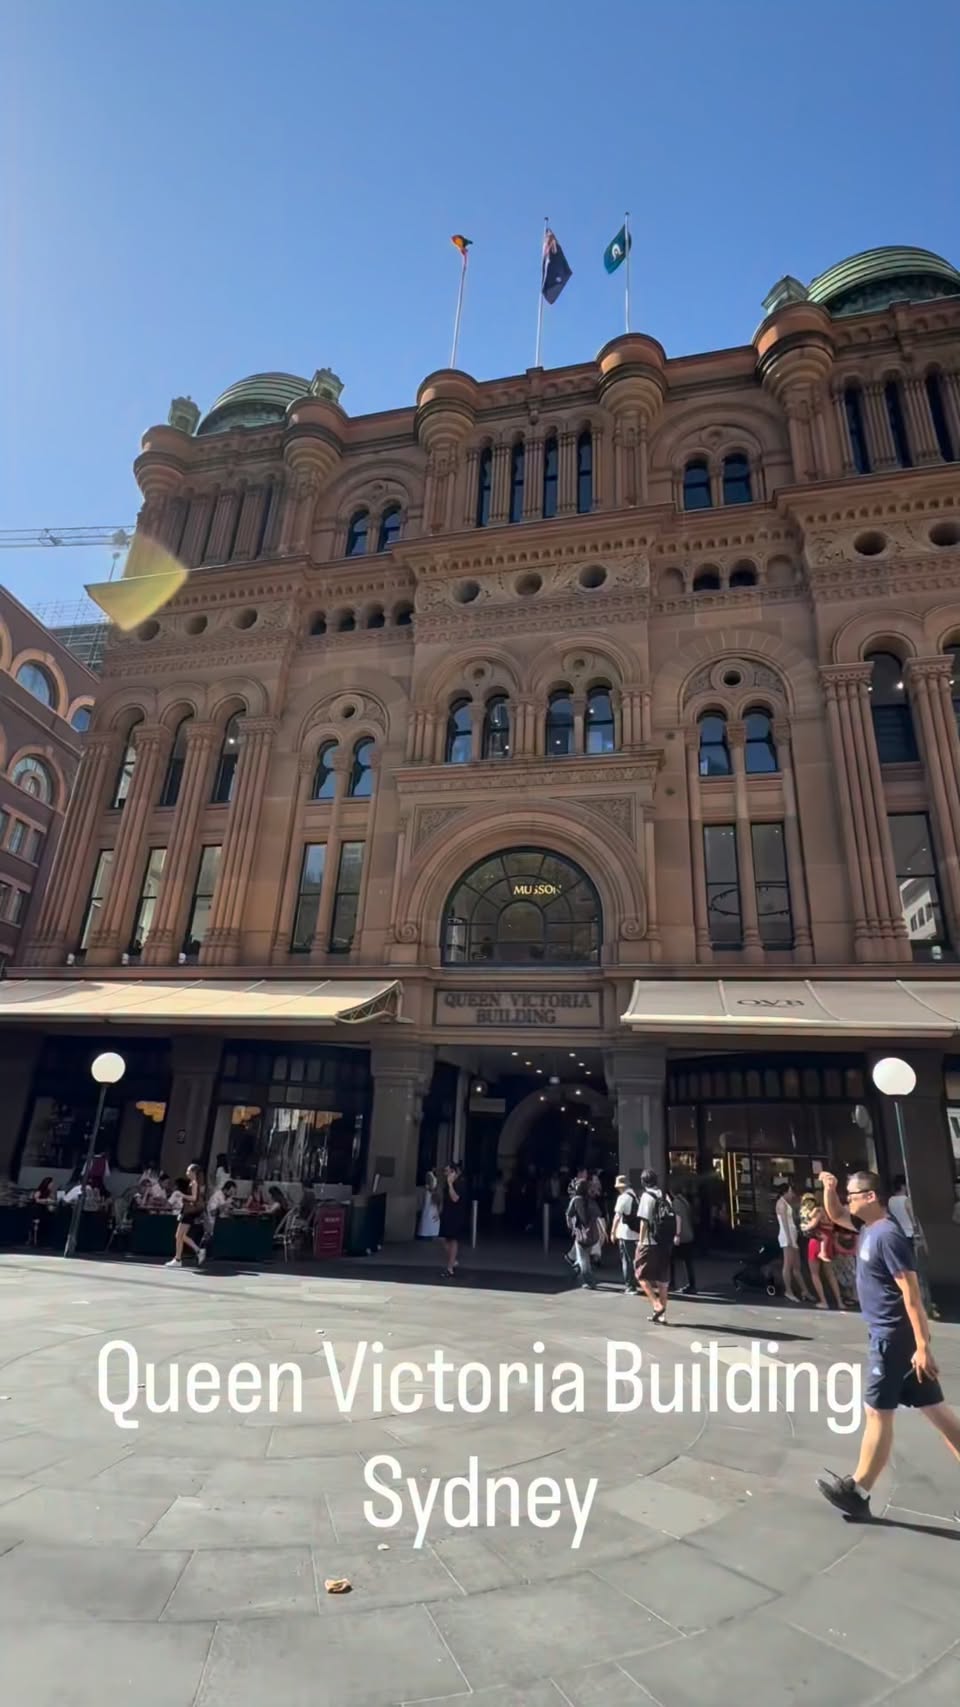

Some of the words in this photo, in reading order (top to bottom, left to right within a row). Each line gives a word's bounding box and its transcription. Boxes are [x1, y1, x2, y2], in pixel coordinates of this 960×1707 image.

[444, 992, 501, 1008] QUEEN
[511, 993, 592, 1008] VICTORIA
[476, 1008, 557, 1025] BUILDING
